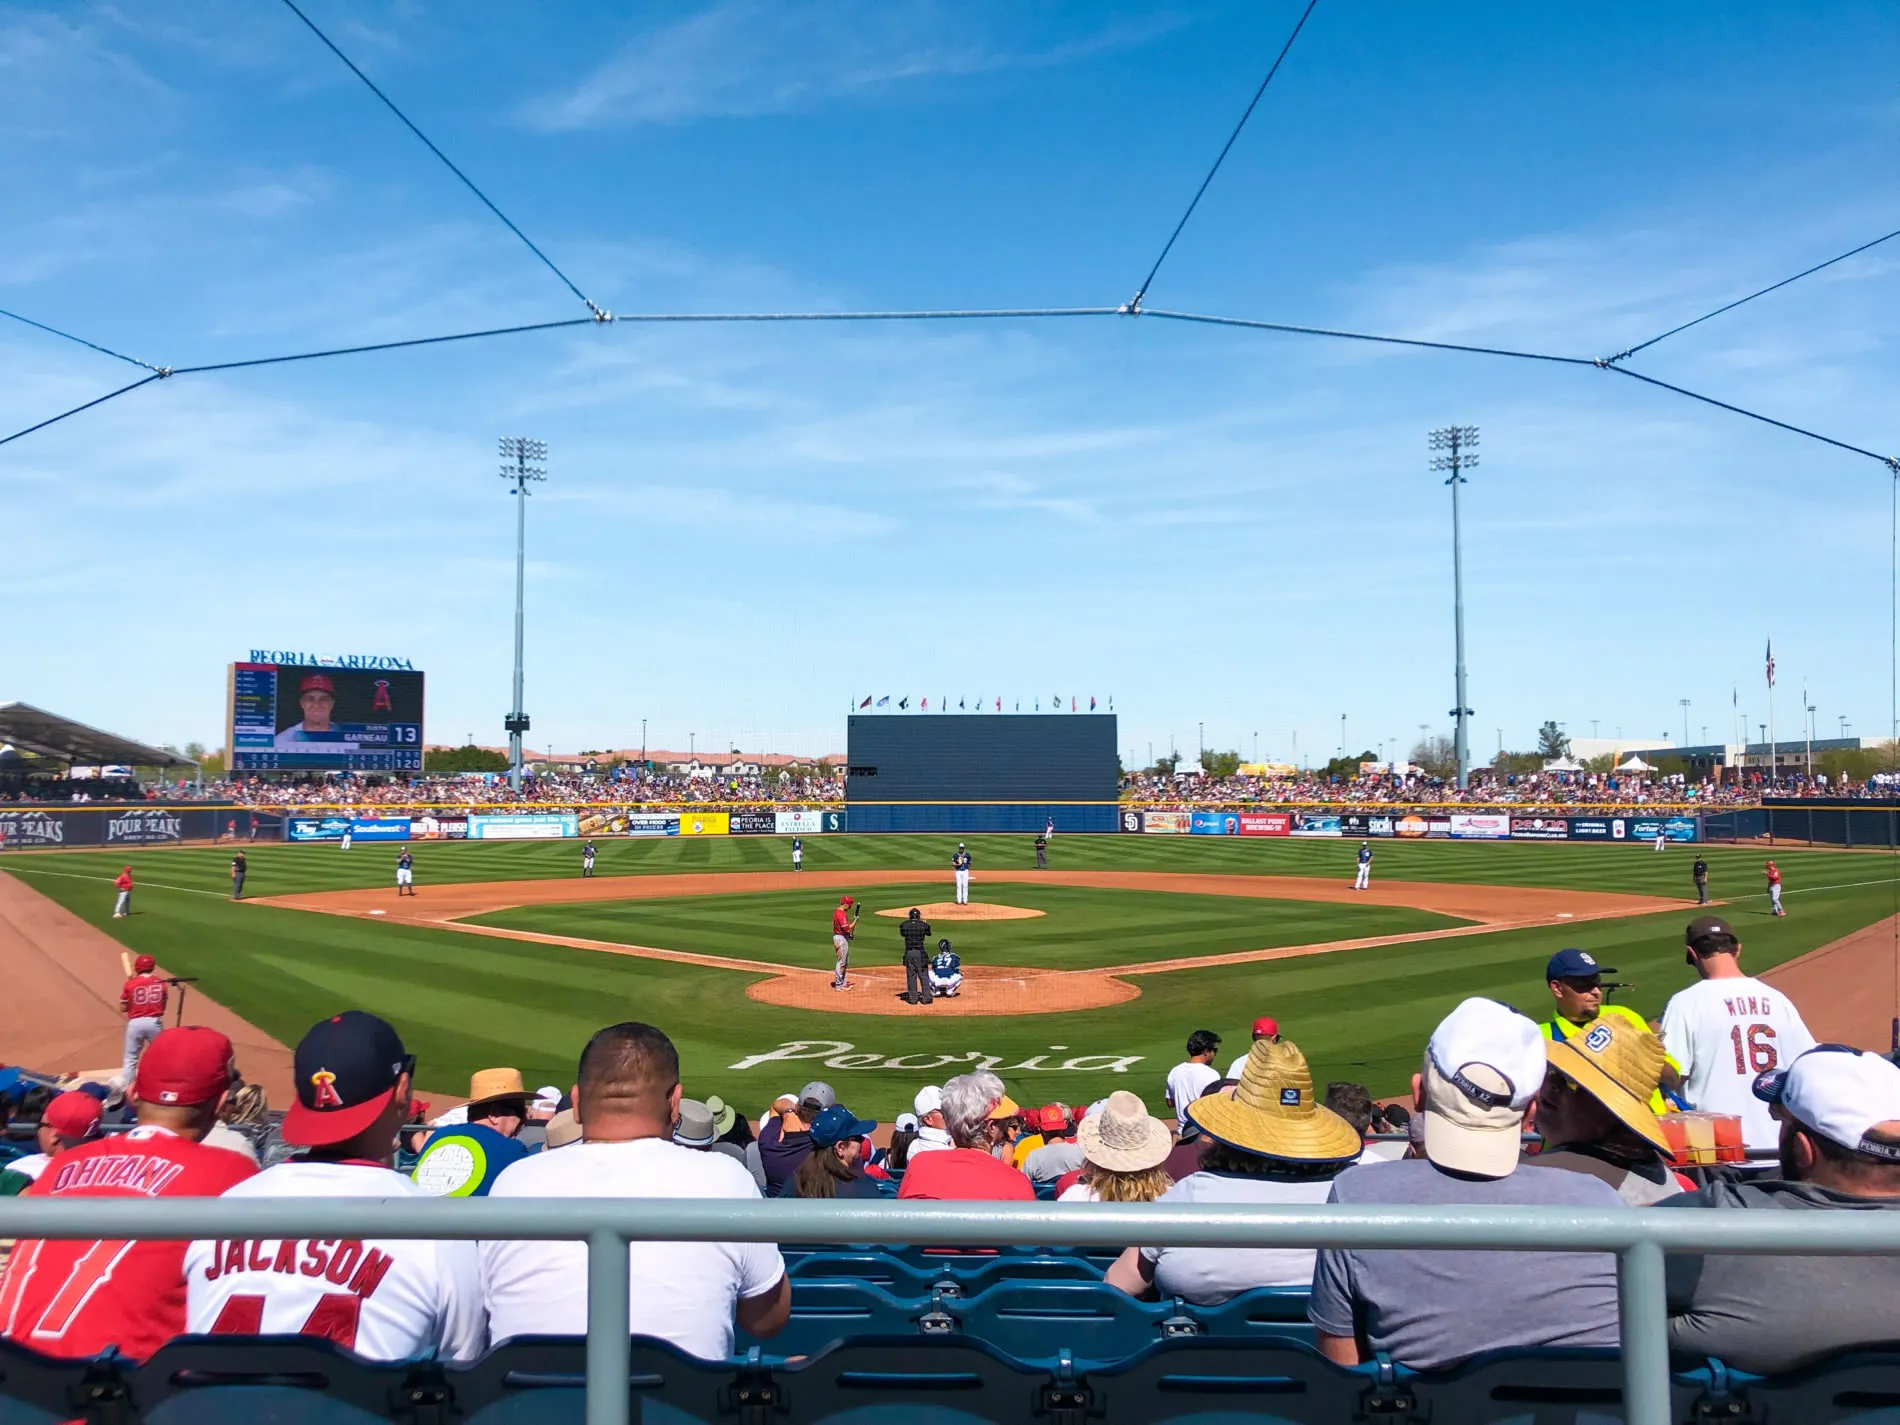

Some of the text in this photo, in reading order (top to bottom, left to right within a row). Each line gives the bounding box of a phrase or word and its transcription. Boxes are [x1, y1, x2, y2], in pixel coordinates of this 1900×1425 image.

[250, 650, 414, 671] PEORIA ARIZONA
[343, 733, 389, 742] GARNEAU
[394, 727, 417, 743] 13
[107, 819, 142, 841] FOUR
[353, 823, 401, 833] Southwest
[829, 813, 838, 830] S
[1125, 813, 1138, 831] SD
[133, 983, 163, 1006] 85
[1723, 996, 1772, 1017] WONG
[1585, 1024, 1614, 1053] SD
[1730, 1023, 1778, 1075] 16
[727, 1040, 1147, 1074] Peoria
[311, 1066, 344, 1108] A
[51, 1154, 185, 1198] OHTANI
[204, 1239, 394, 1299] JACKSON
